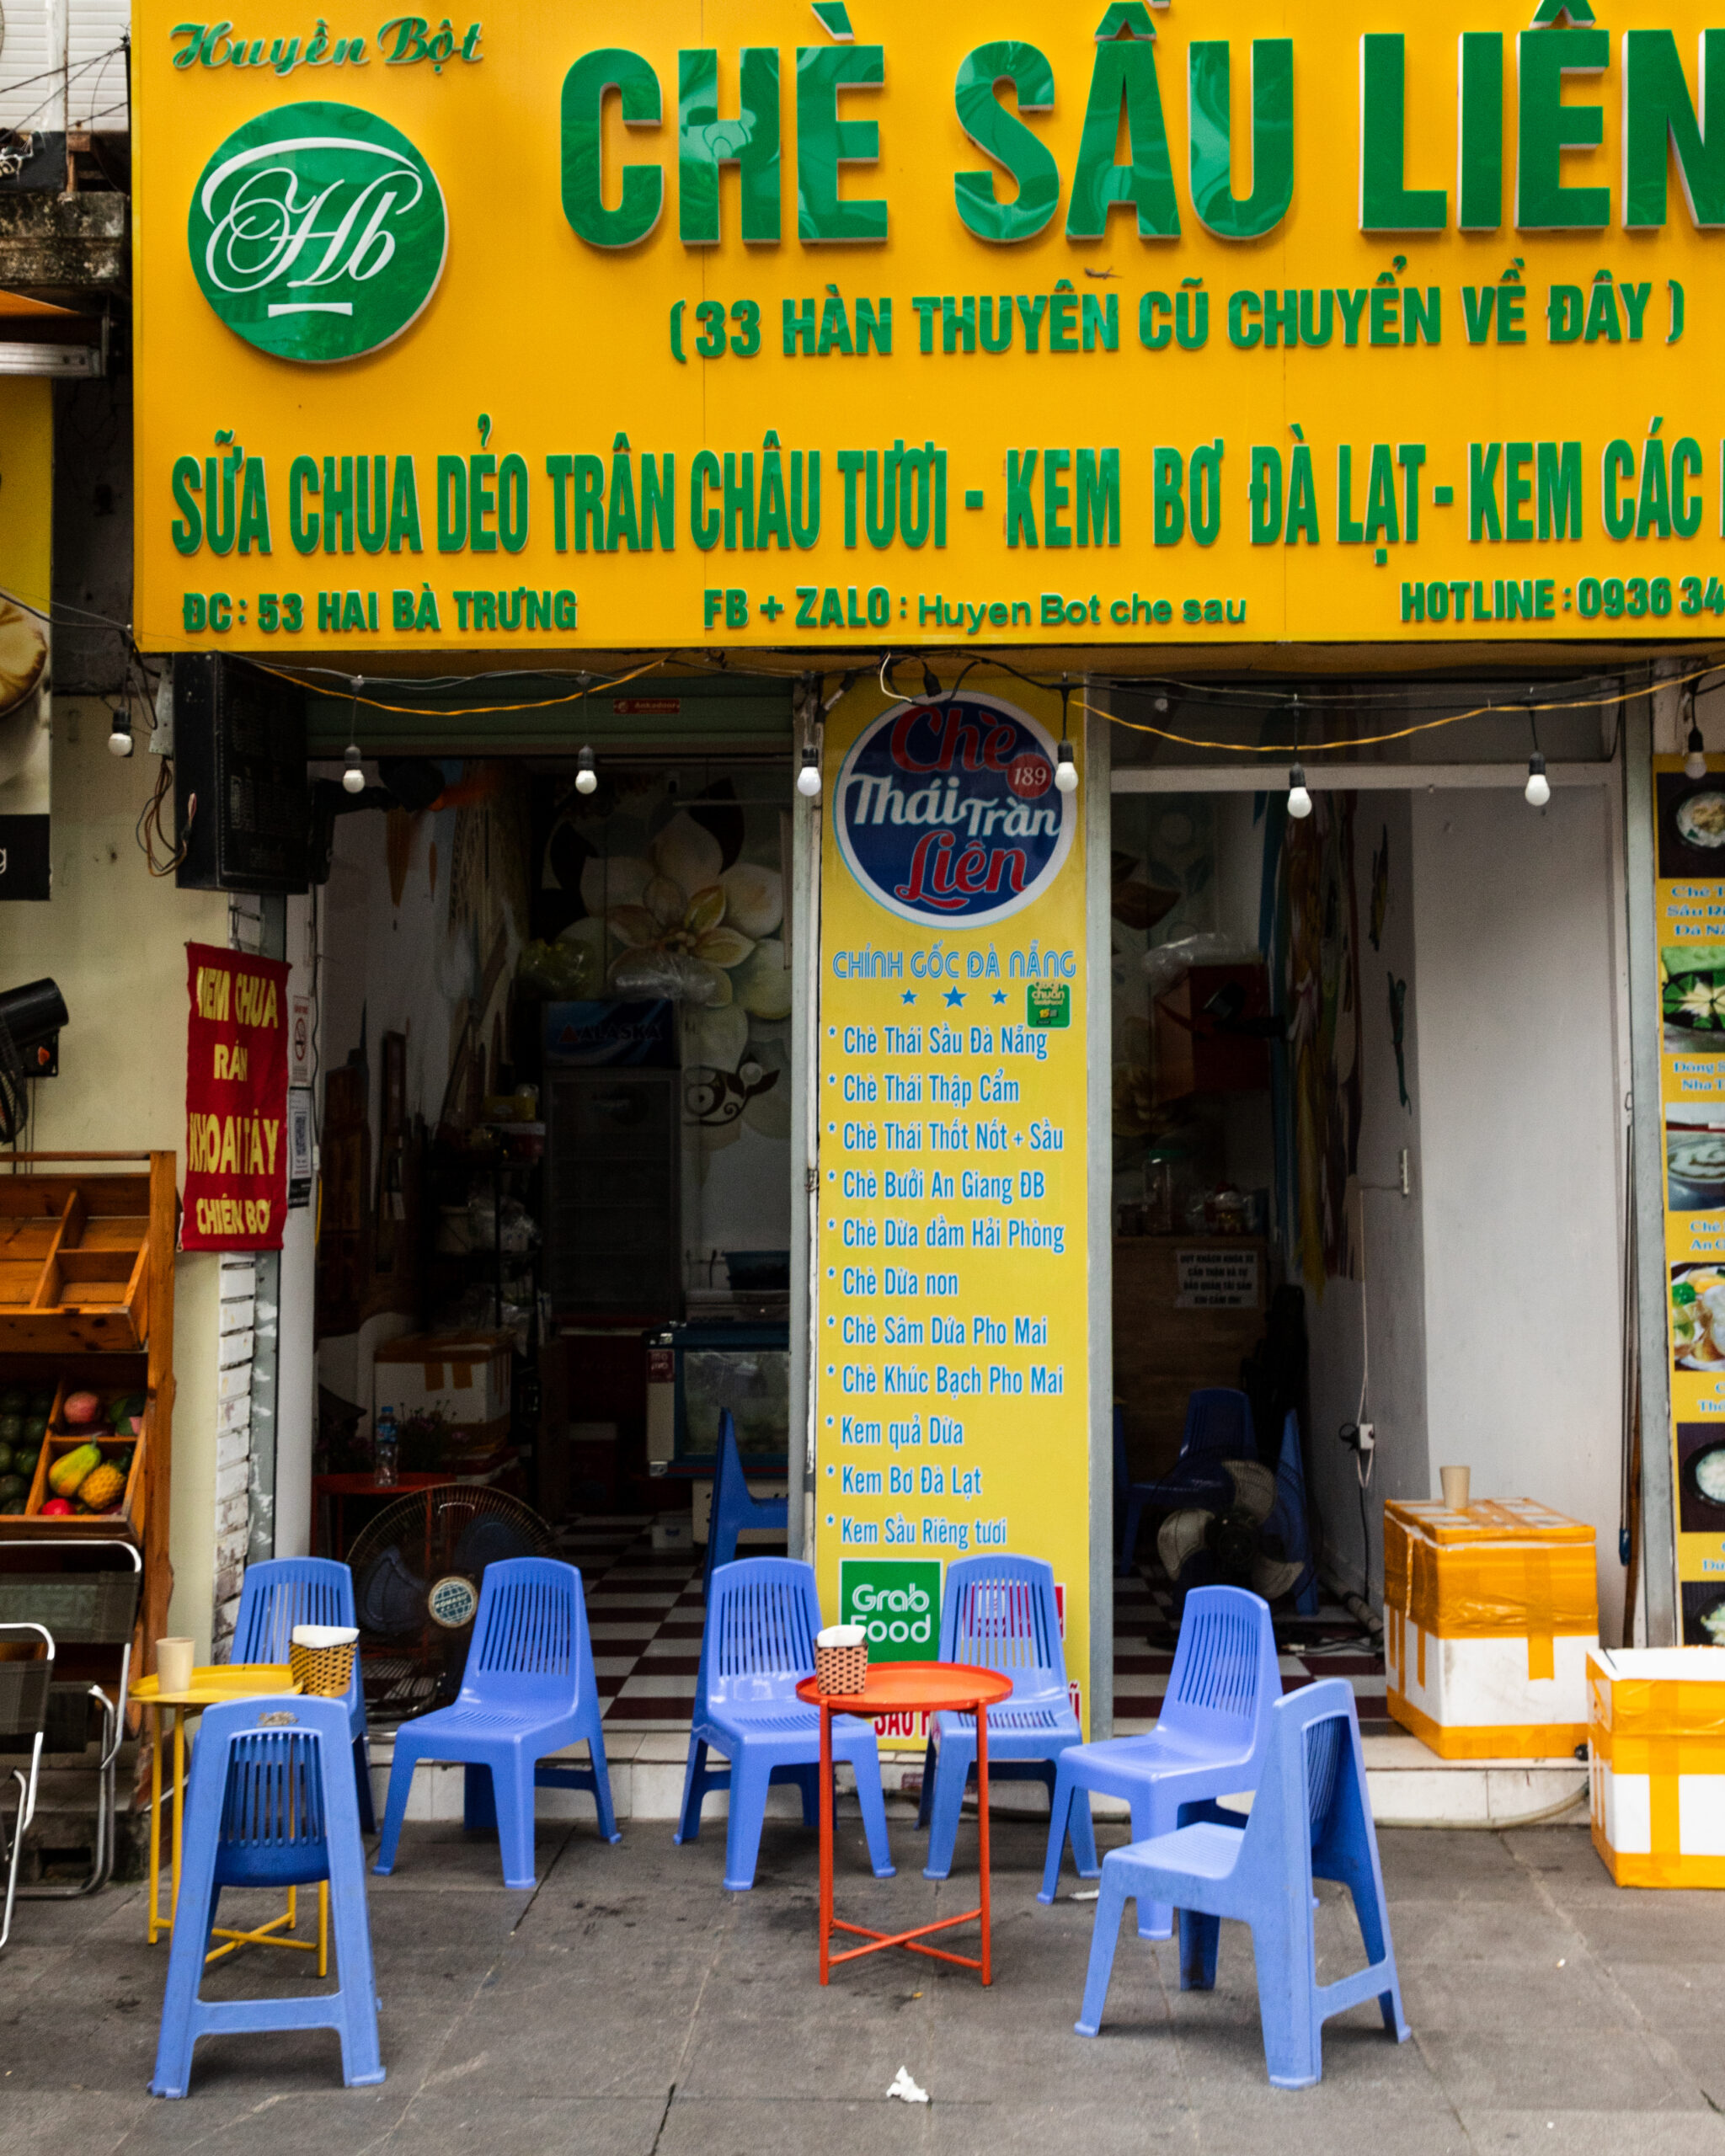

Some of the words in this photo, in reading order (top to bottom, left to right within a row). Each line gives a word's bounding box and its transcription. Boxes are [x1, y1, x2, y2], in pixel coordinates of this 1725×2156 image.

[169, 19, 368, 76] Huyền
[377, 17, 483, 73] Bột
[560, 2, 889, 247] CHÈ
[1359, 0, 1725, 232] LIÊN
[782, 283, 893, 355] HÀN
[911, 279, 1119, 353] THUYÊN
[1139, 276, 1210, 350] CŨ
[1228, 255, 1441, 348] CHUYỂN
[1460, 257, 1527, 344] VỀ
[171, 429, 273, 555] SỮA
[289, 454, 423, 555] CHUA
[437, 413, 530, 553] DẺO
[546, 430, 676, 552] TRÂN
[690, 429, 821, 550] CHÂU
[837, 438, 948, 548] TƯƠI
[1006, 447, 1121, 547] KEM
[1153, 438, 1225, 546] BƠ
[1248, 423, 1320, 544] ĐÀ
[1337, 443, 1427, 564] LẠT
[1468, 440, 1583, 541] KEM
[1602, 416, 1703, 541] CÁC
[257, 591, 304, 632] 53
[318, 590, 379, 630] HAI
[392, 581, 441, 630] BÀ
[451, 585, 579, 630] TRƯNG
[703, 588, 749, 628] FB
[918, 594, 1032, 633] Huyen
[1040, 593, 1101, 625] Bot
[1109, 592, 1172, 623] che
[1182, 599, 1247, 623] sau
[890, 705, 1017, 773] Chè
[1013, 766, 1049, 787] 189
[847, 773, 965, 825] Thái
[895, 830, 1028, 910] Liên
[235, 972, 279, 1029] CHUA
[843, 1027, 877, 1054] Chè
[884, 1026, 921, 1054] Thái
[929, 1022, 963, 1054] Sầu
[969, 1026, 993, 1054] Đà
[213, 1038, 248, 1082] RÁN
[843, 1074, 877, 1102] Chè
[884, 1074, 921, 1102] Thái
[928, 1073, 972, 1108] Thập
[979, 1069, 1020, 1102] Cẩm
[843, 1122, 877, 1150] Chè
[884, 1122, 921, 1150] Thái
[928, 1118, 969, 1150] Thốt
[975, 1118, 1008, 1150] Nốt
[1029, 1118, 1064, 1150] Sầu
[843, 1170, 877, 1198] Chè
[884, 1167, 924, 1198] Bưởi
[931, 1170, 954, 1198] An
[961, 1170, 1013, 1205] Giang
[1019, 1170, 1045, 1198] ĐB
[842, 1219, 877, 1247] Chè
[884, 1219, 919, 1247] Dừa
[971, 1217, 1001, 1247] Hải
[1008, 1219, 1065, 1254] Phòng
[842, 1267, 877, 1296] Chè
[884, 1267, 919, 1296] Dừa
[926, 1273, 959, 1296] non
[842, 1315, 877, 1345] Chè
[884, 1315, 924, 1345] Sâm
[931, 1315, 966, 1345] Dứa
[973, 1316, 1007, 1345] Pho
[1014, 1316, 1047, 1345] Mai
[842, 1364, 877, 1394] Chè
[884, 1364, 929, 1394] Khúc
[936, 1365, 982, 1400] Bạch
[989, 1365, 1023, 1395] Pho
[1030, 1365, 1063, 1395] Mai
[841, 1416, 882, 1445] Kem
[889, 1414, 921, 1451] quả
[929, 1416, 964, 1445] Dừa
[842, 1465, 883, 1495] Kem
[889, 1465, 914, 1495] Bơ
[920, 1465, 944, 1495] Đà
[952, 1465, 982, 1501] Lạt
[841, 1517, 879, 1545] Kem
[884, 1513, 916, 1545] Sầu
[922, 1518, 969, 1550] Riêng
[974, 1518, 1007, 1545] tươi
[852, 1582, 930, 1613] Grab
